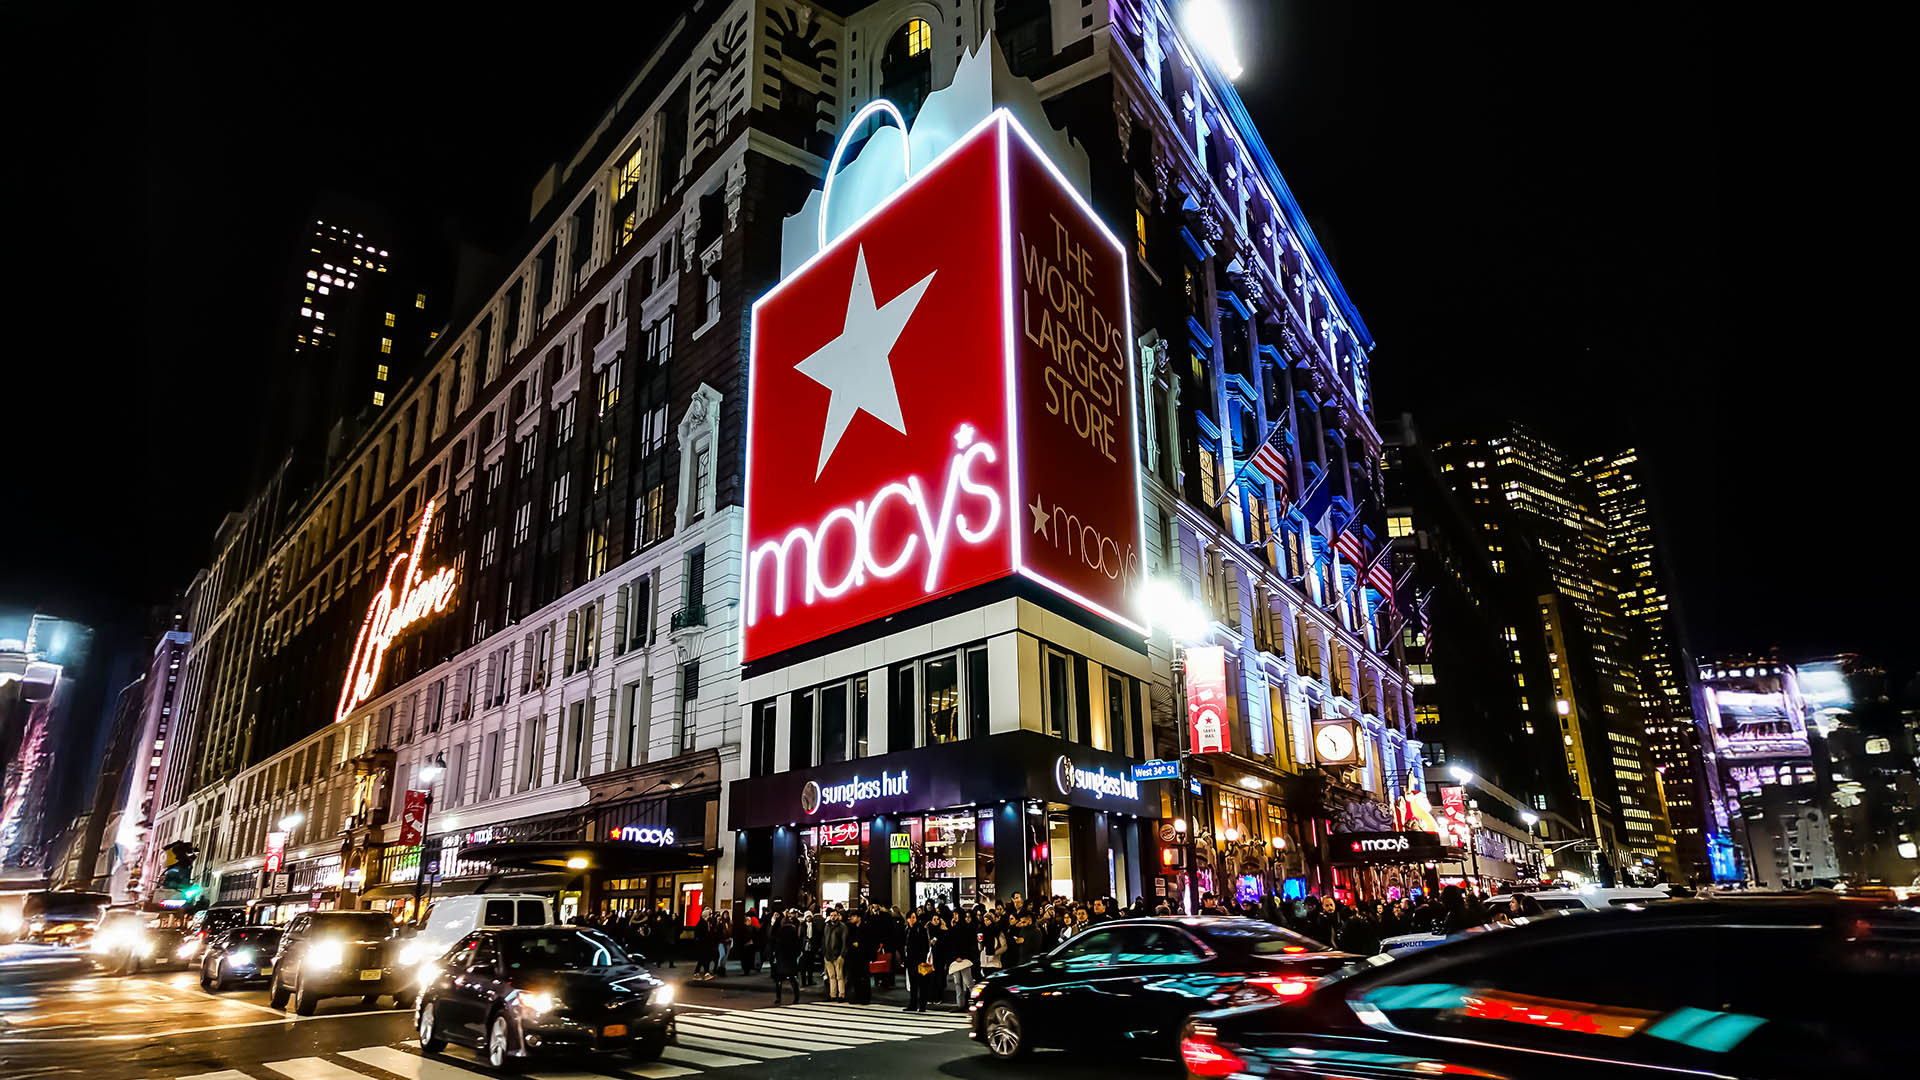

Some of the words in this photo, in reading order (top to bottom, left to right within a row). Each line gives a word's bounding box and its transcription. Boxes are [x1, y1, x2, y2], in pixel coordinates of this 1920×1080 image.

[1049, 213, 1096, 297] THE
[1019, 232, 1125, 370] WORLD'S
[1022, 288, 1124, 417] LARGEST
[1044, 365, 1118, 464] STORE
[747, 424, 1001, 627] macy's
[1052, 503, 1139, 599] macy's
[821, 775, 882, 809] sunglass
[882, 769, 909, 797] hut
[1074, 767, 1120, 799] sunglass
[1120, 771, 1139, 801] hut
[1134, 768, 1152, 778] West
[1153, 765, 1167, 776] 34th
[1167, 765, 1176, 775] St
[621, 826, 675, 848] macy's
[1360, 835, 1410, 853] macy's
